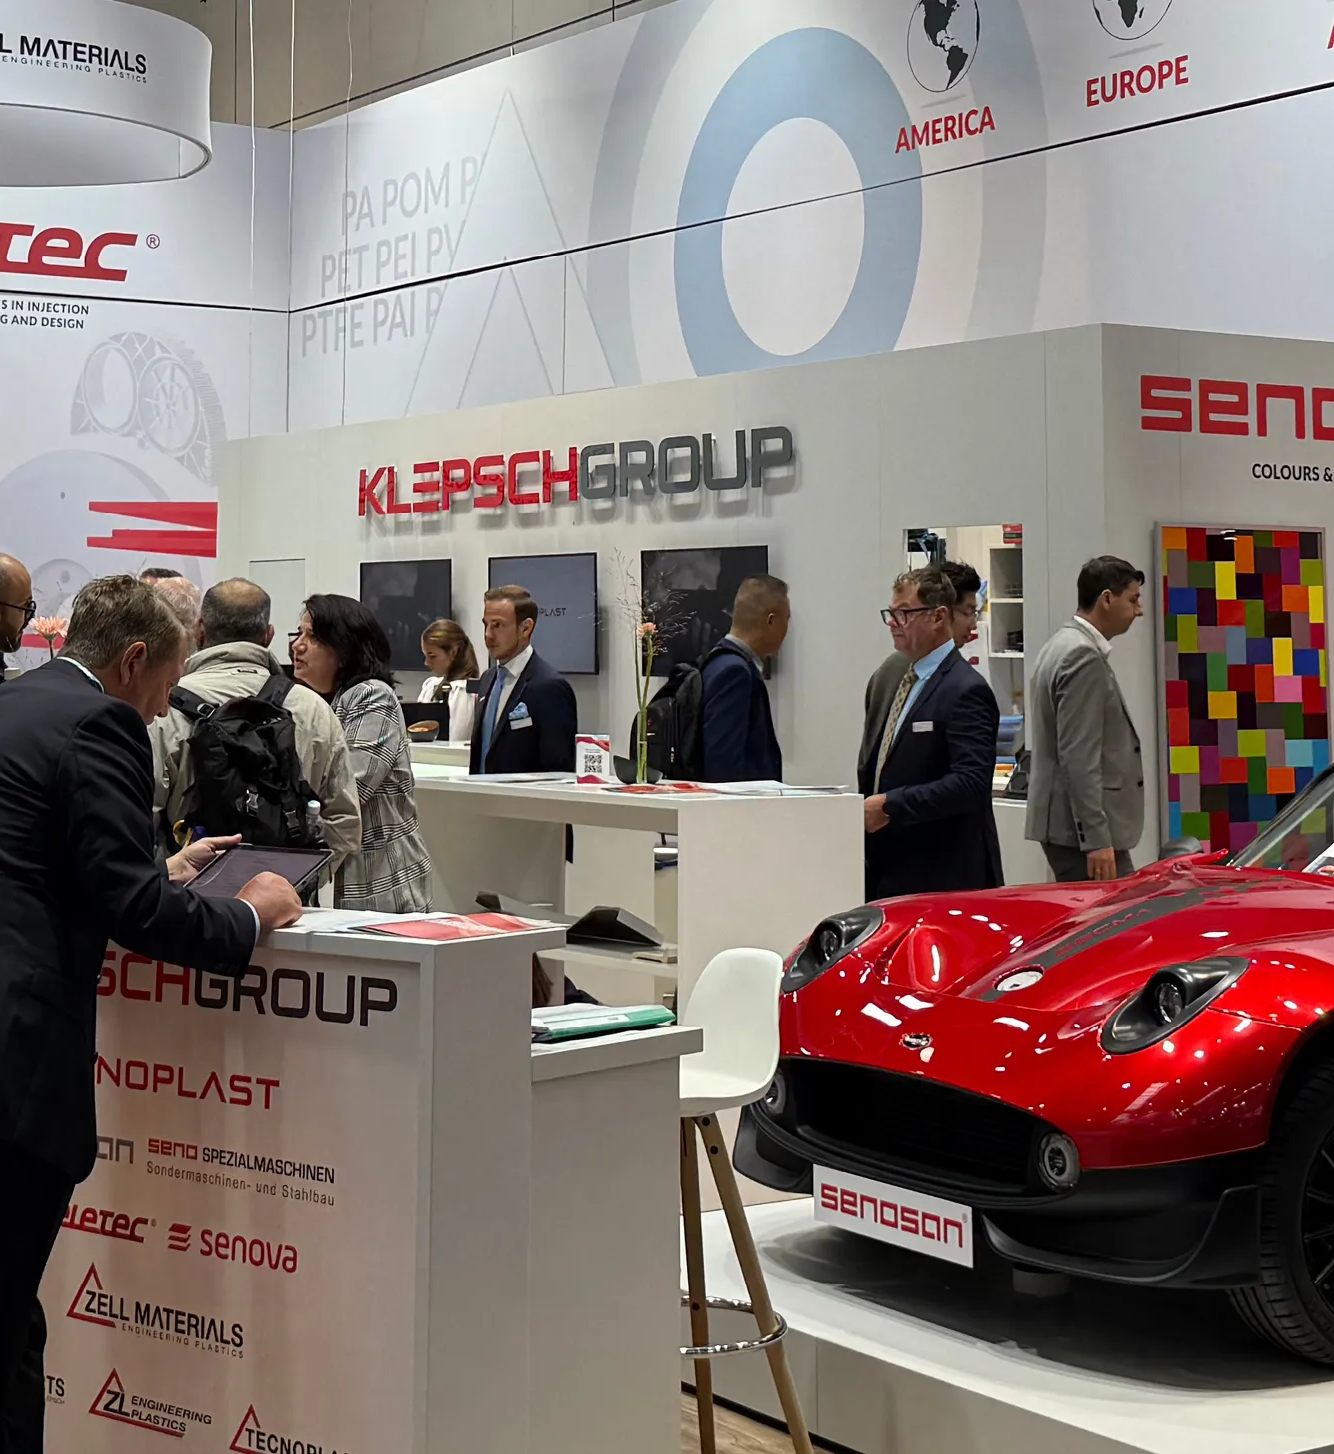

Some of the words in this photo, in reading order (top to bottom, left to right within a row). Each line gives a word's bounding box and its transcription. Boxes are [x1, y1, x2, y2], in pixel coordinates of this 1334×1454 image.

[2, 55, 91, 73] ENGINEERING
[98, 67, 147, 84] PLASTICS
[20, 35, 147, 75] MATERIALS
[1086, 55, 1189, 108] EUROPE
[894, 105, 996, 154] AMERICA
[342, 185, 375, 236] PA
[382, 161, 450, 225] POM
[321, 243, 370, 298] PET
[376, 232, 416, 284] PEI
[11, 300, 25, 311] IN
[28, 300, 89, 315] INJECTION
[11, 315, 38, 327] AND
[41, 317, 84, 329] DESIGN
[301, 302, 365, 358] PTFE
[373, 290, 416, 345] PAI
[358, 425, 793, 517] KLEPSCHGROUP
[1251, 463, 1320, 483] COLOURS
[1323, 466, 1334, 483] &
[146, 1161, 251, 1189] Sondermaschinen-
[256, 1182, 276, 1196] und
[282, 1185, 335, 1206] Stahlbau
[202, 1147, 335, 1184] SPEZIALMASCHINEN
[199, 1228, 298, 1274] senova
[84, 1289, 130, 1322] ZELL
[134, 1301, 244, 1348] MATERIALS
[122, 1322, 189, 1346] ENGINEERING
[195, 1340, 244, 1359] PLASTICS
[102, 1388, 130, 1417] ZL
[131, 1394, 212, 1425] ENGINEERING
[131, 1410, 187, 1433] PLASTICS
